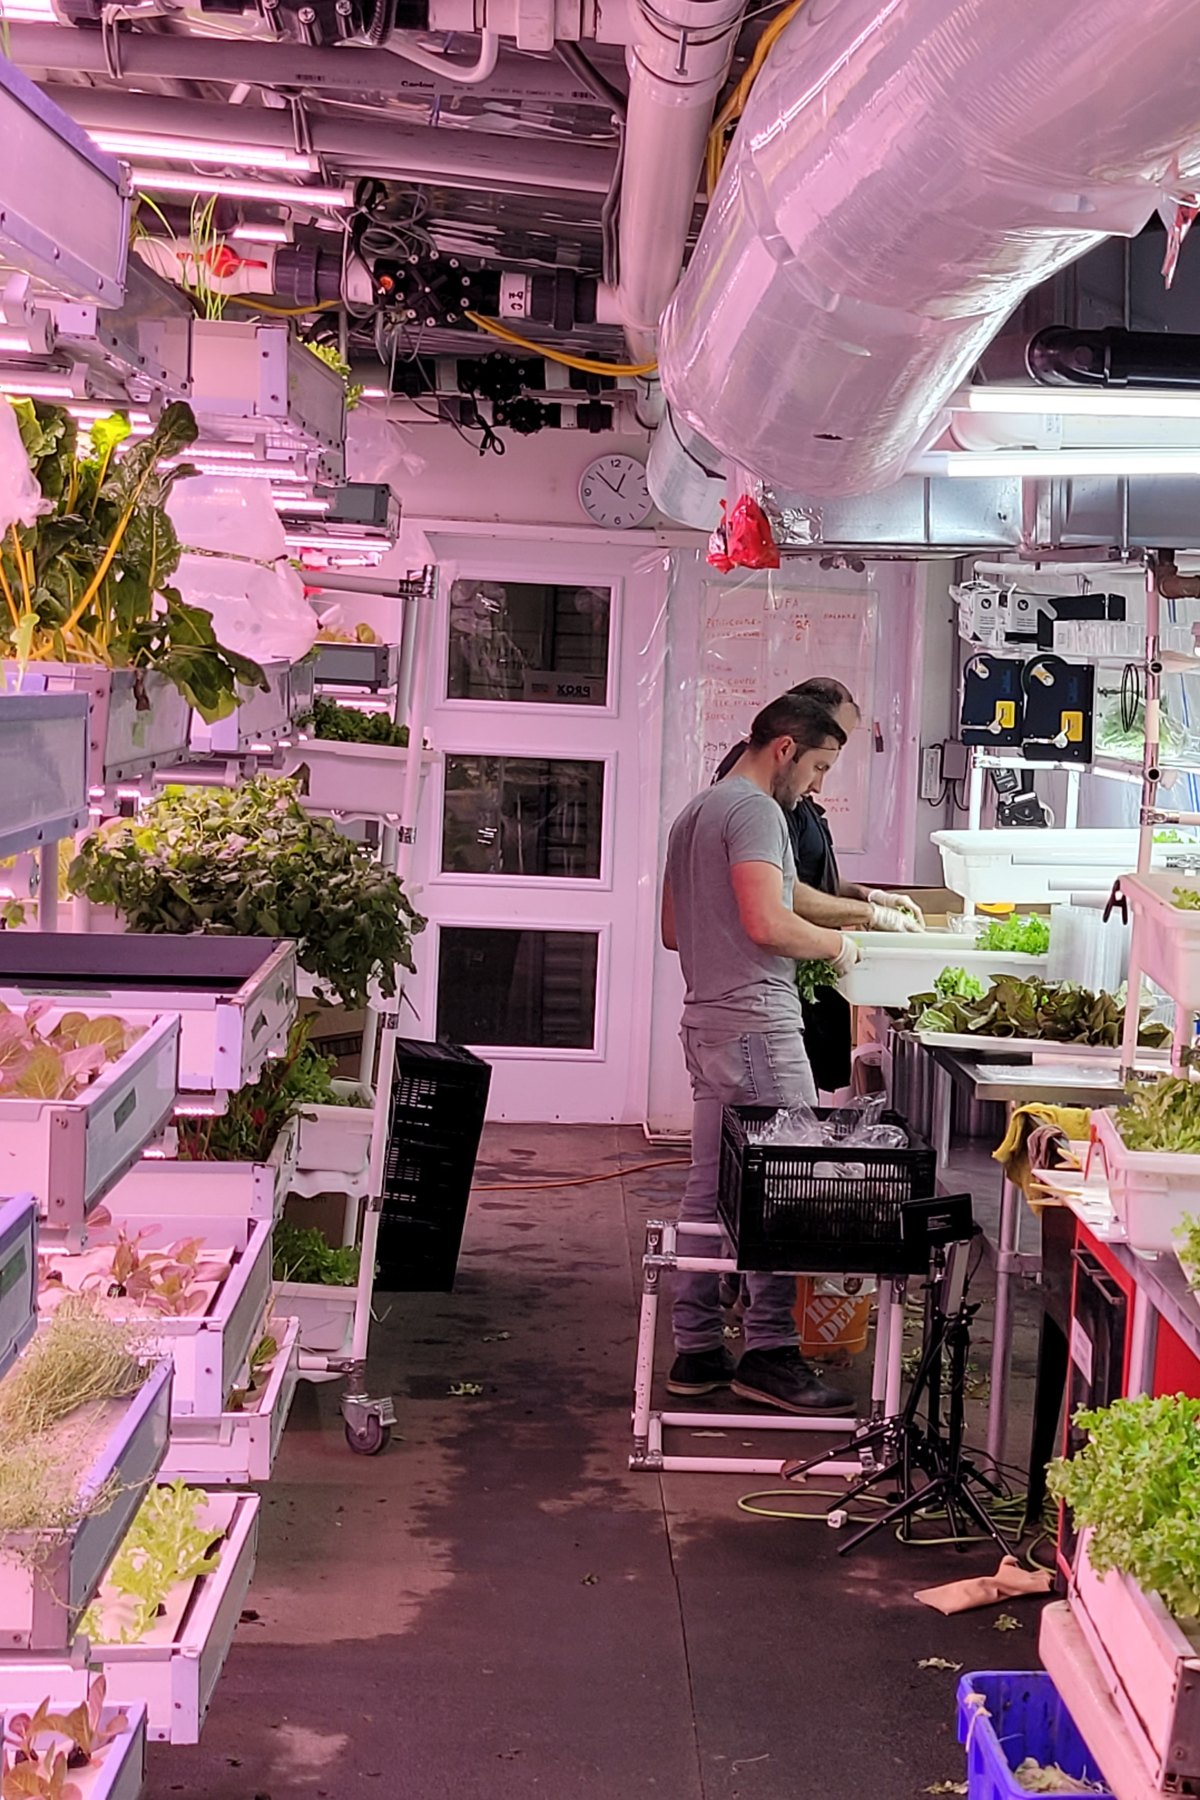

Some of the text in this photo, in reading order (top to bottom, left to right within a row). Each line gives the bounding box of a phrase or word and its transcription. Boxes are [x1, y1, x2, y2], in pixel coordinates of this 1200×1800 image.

[611, 459, 622, 468] 12
[584, 488, 592, 496] 9
[614, 516, 622, 525] 6
